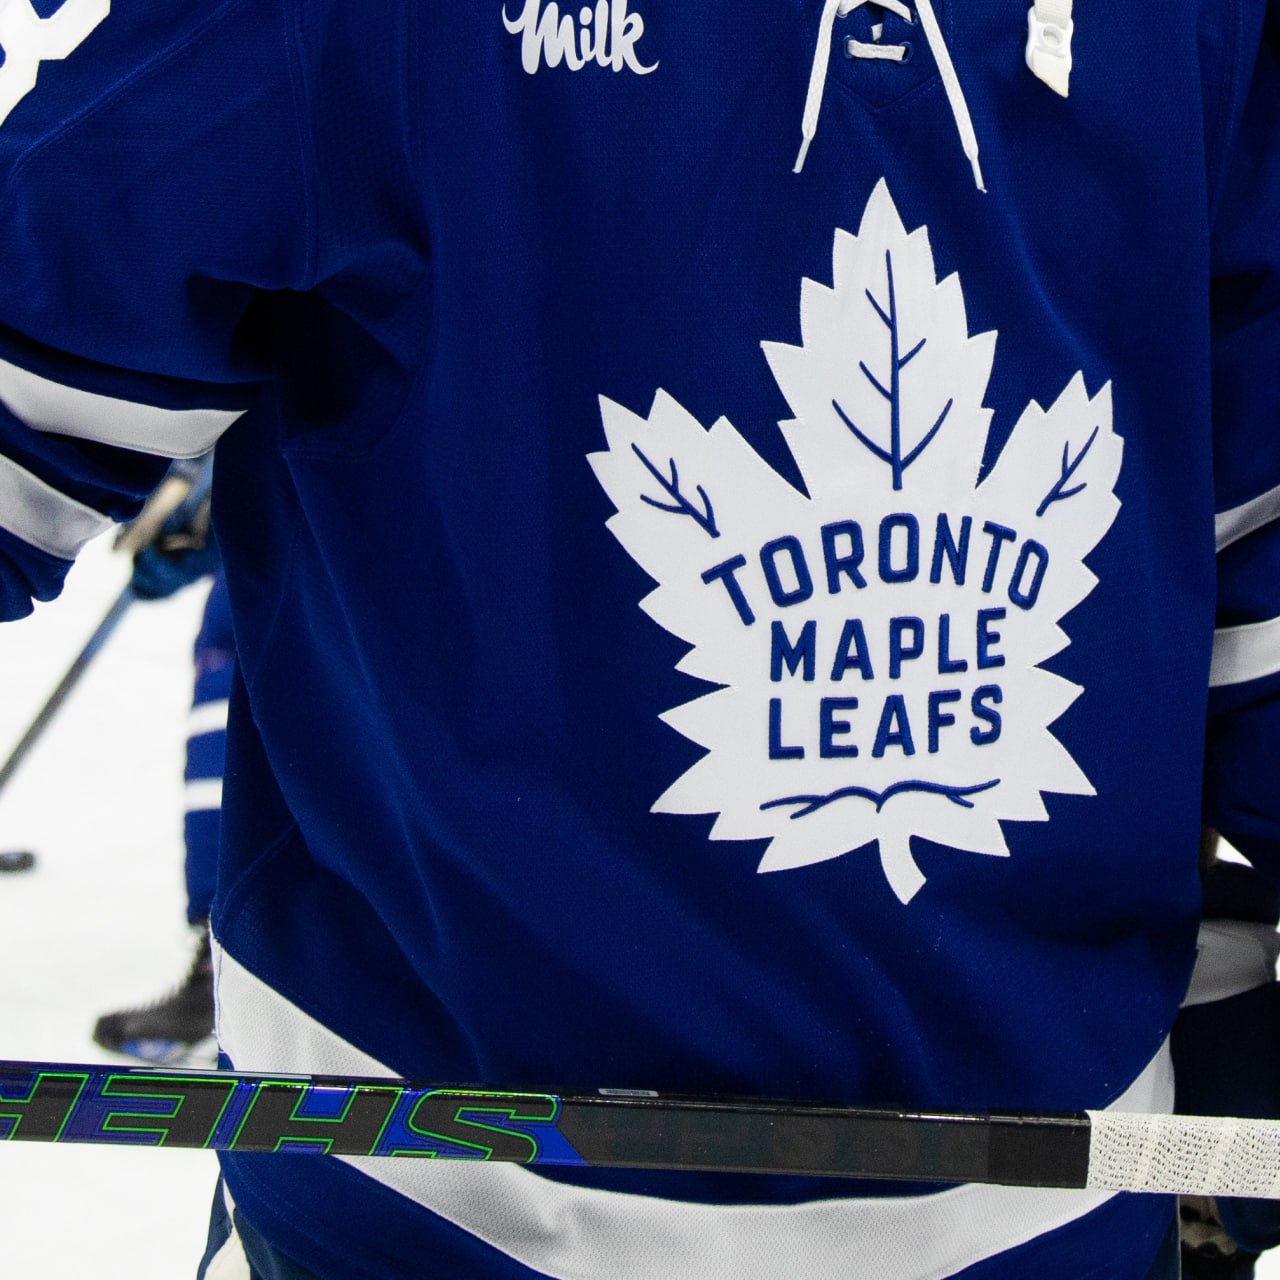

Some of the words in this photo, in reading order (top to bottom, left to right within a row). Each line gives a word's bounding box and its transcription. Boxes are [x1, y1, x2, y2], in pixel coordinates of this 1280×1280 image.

[700, 512, 1049, 626] TORONTO
[770, 607, 1006, 682] MAPLE
[768, 684, 1003, 760] LEAFS
